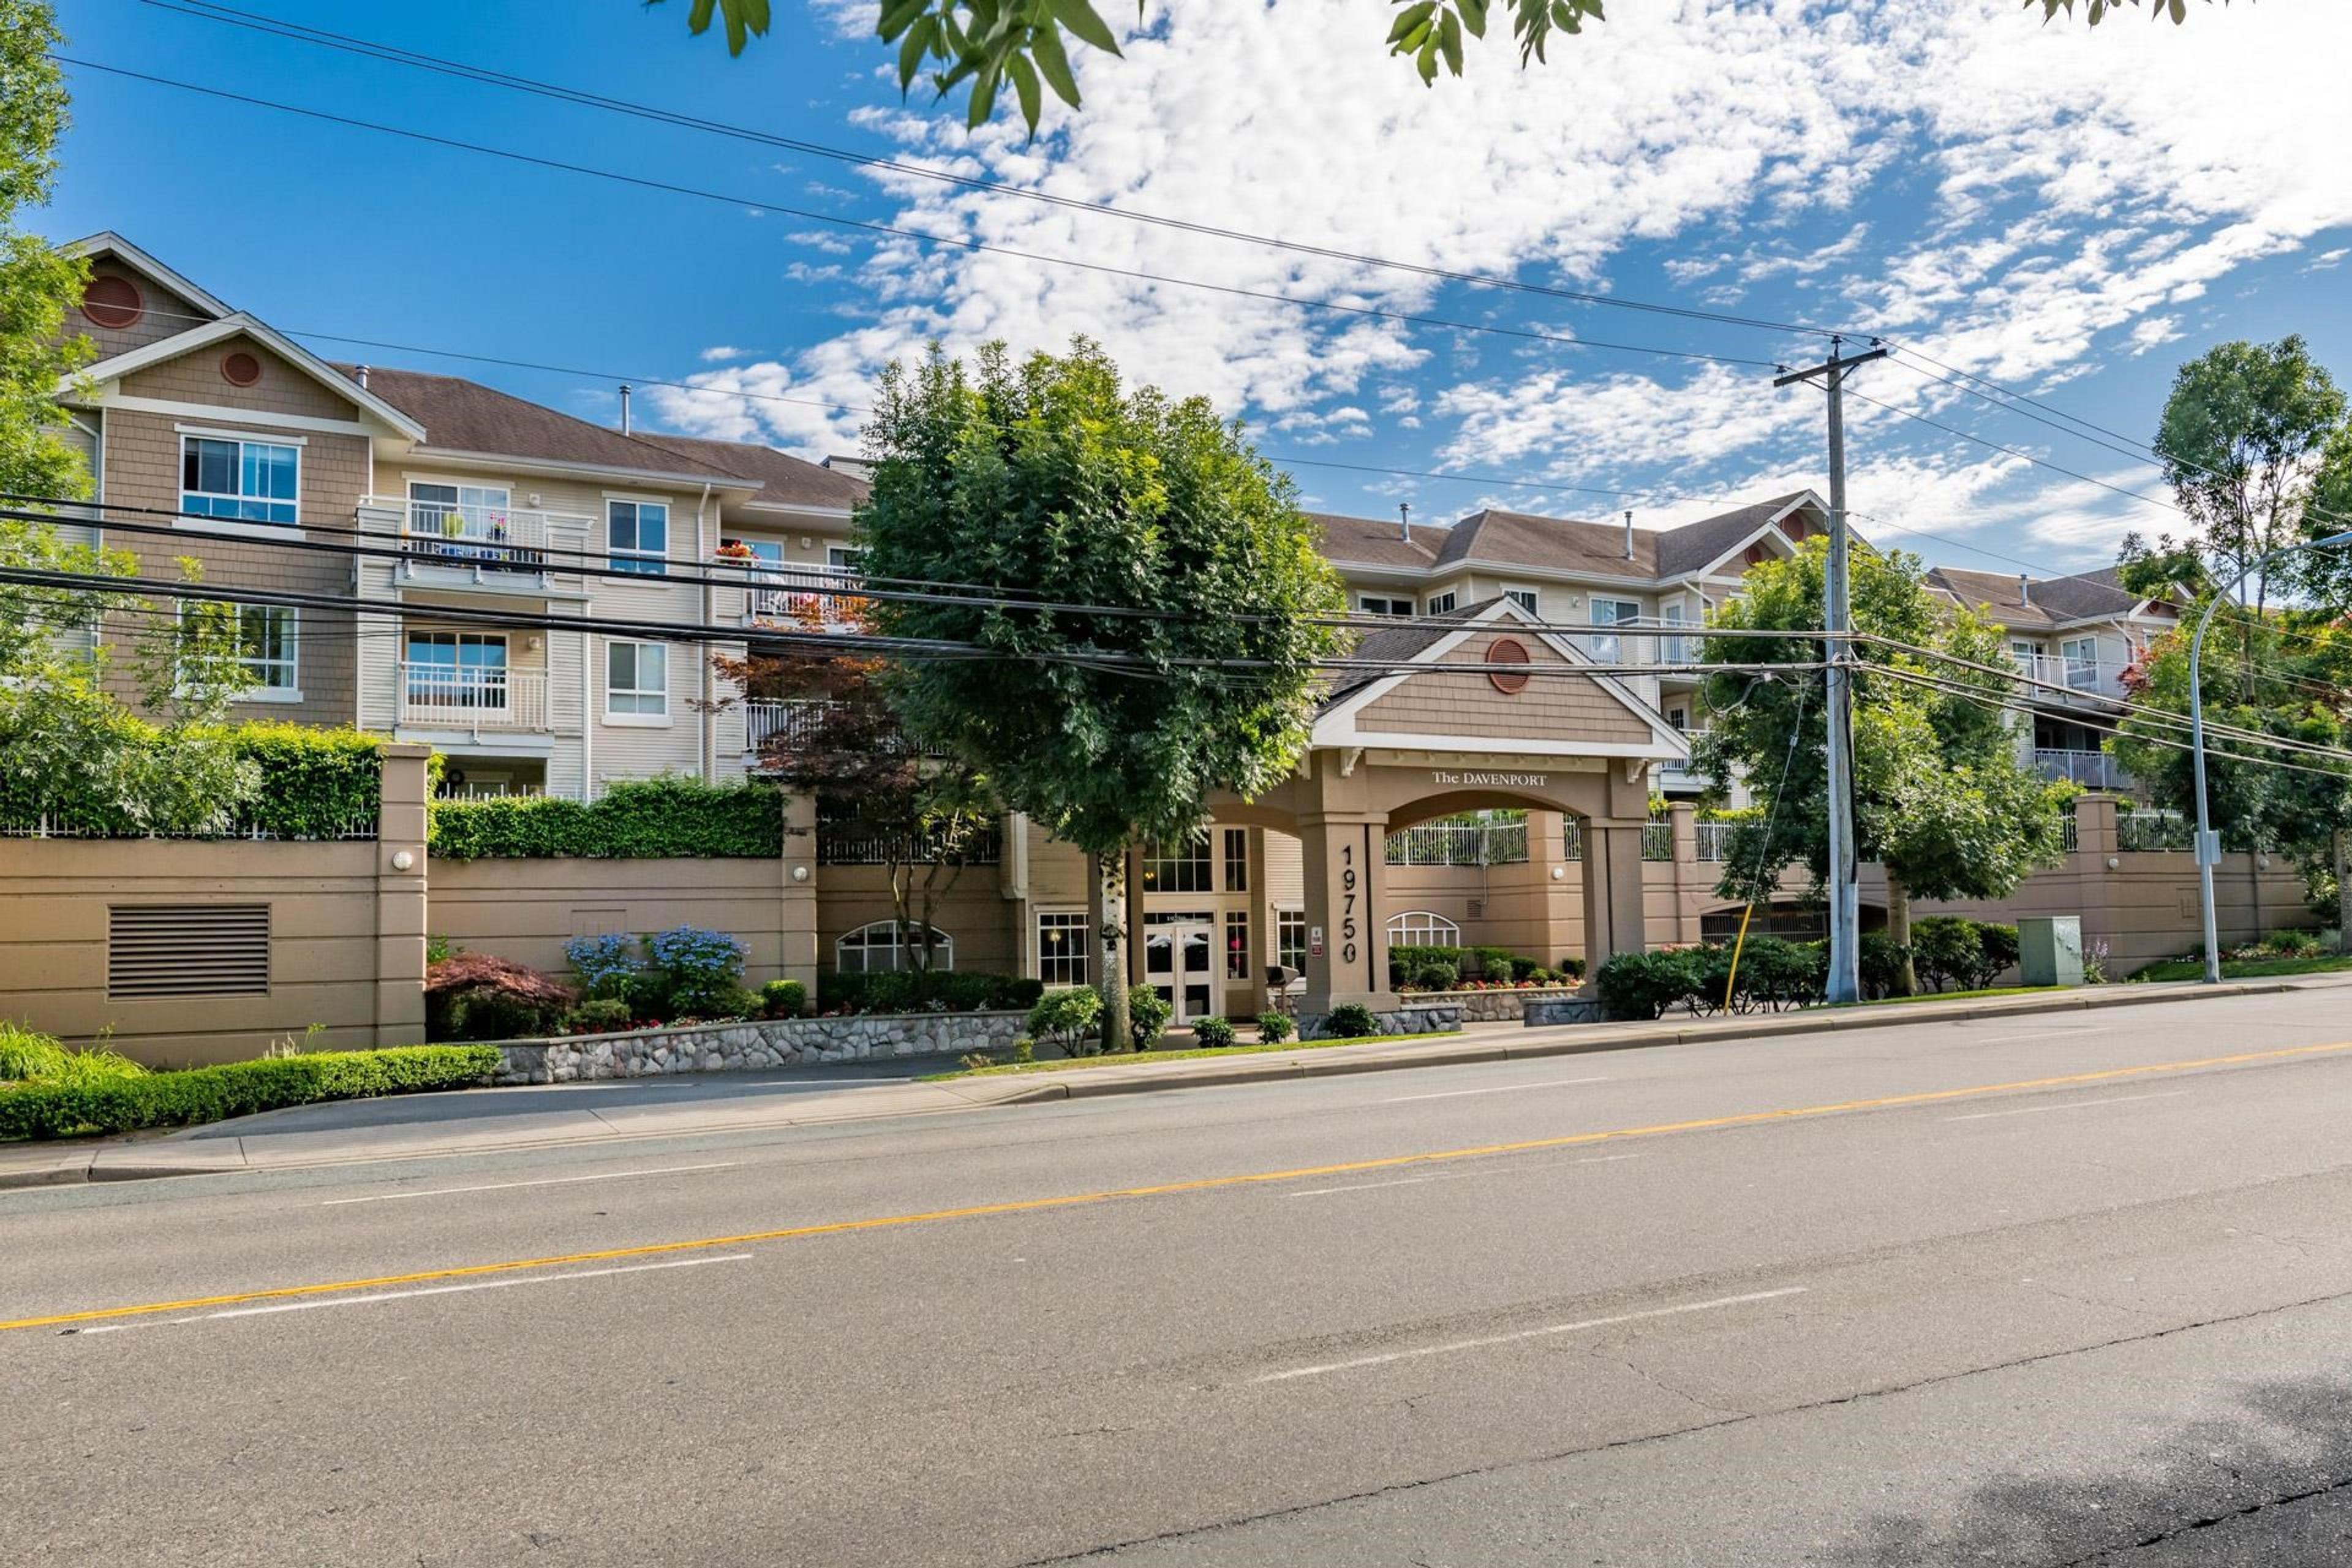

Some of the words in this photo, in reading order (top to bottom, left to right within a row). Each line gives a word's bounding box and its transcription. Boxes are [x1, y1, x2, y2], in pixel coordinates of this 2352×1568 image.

[1432, 772, 1459, 783] The
[1463, 772, 1547, 786] DAVENPORT
[1342, 844, 1356, 963] 19750
